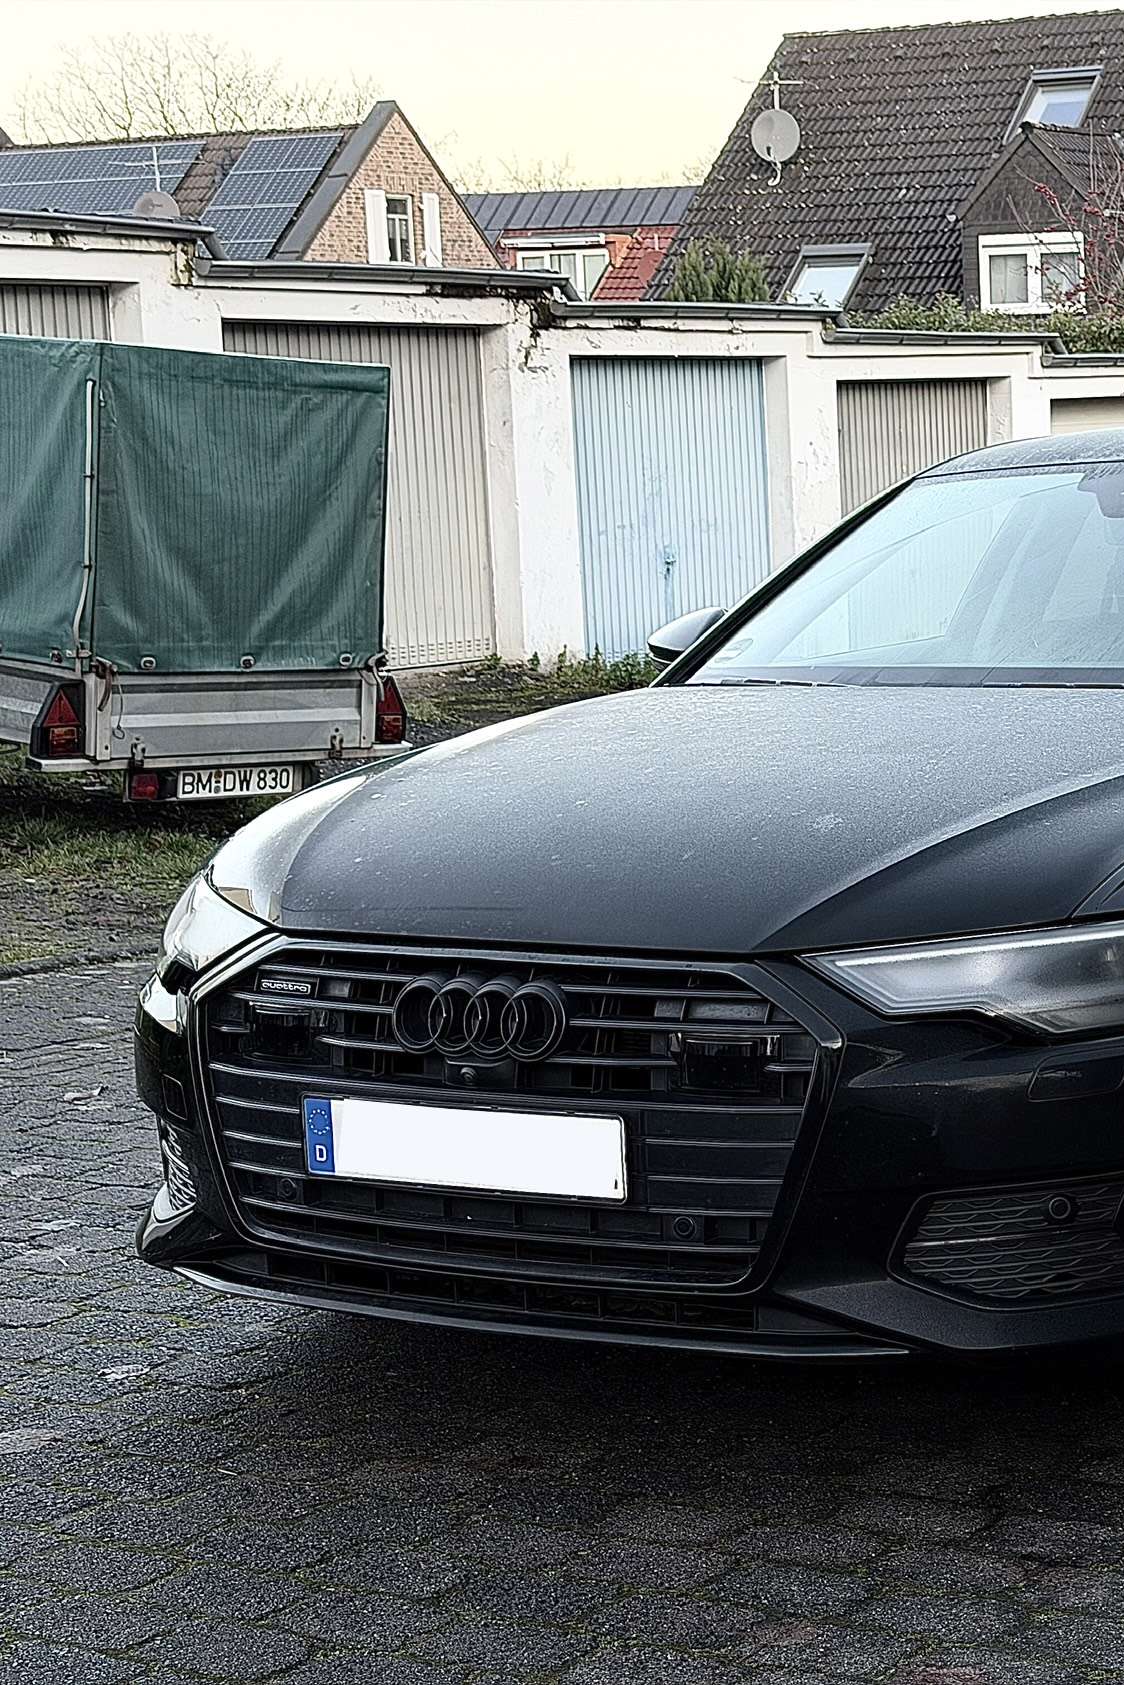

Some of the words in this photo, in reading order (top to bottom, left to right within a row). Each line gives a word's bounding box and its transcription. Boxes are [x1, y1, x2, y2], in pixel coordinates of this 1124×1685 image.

[257, 768, 290, 791] 830
[262, 982, 307, 992] quattro
[315, 1144, 327, 1162] D
